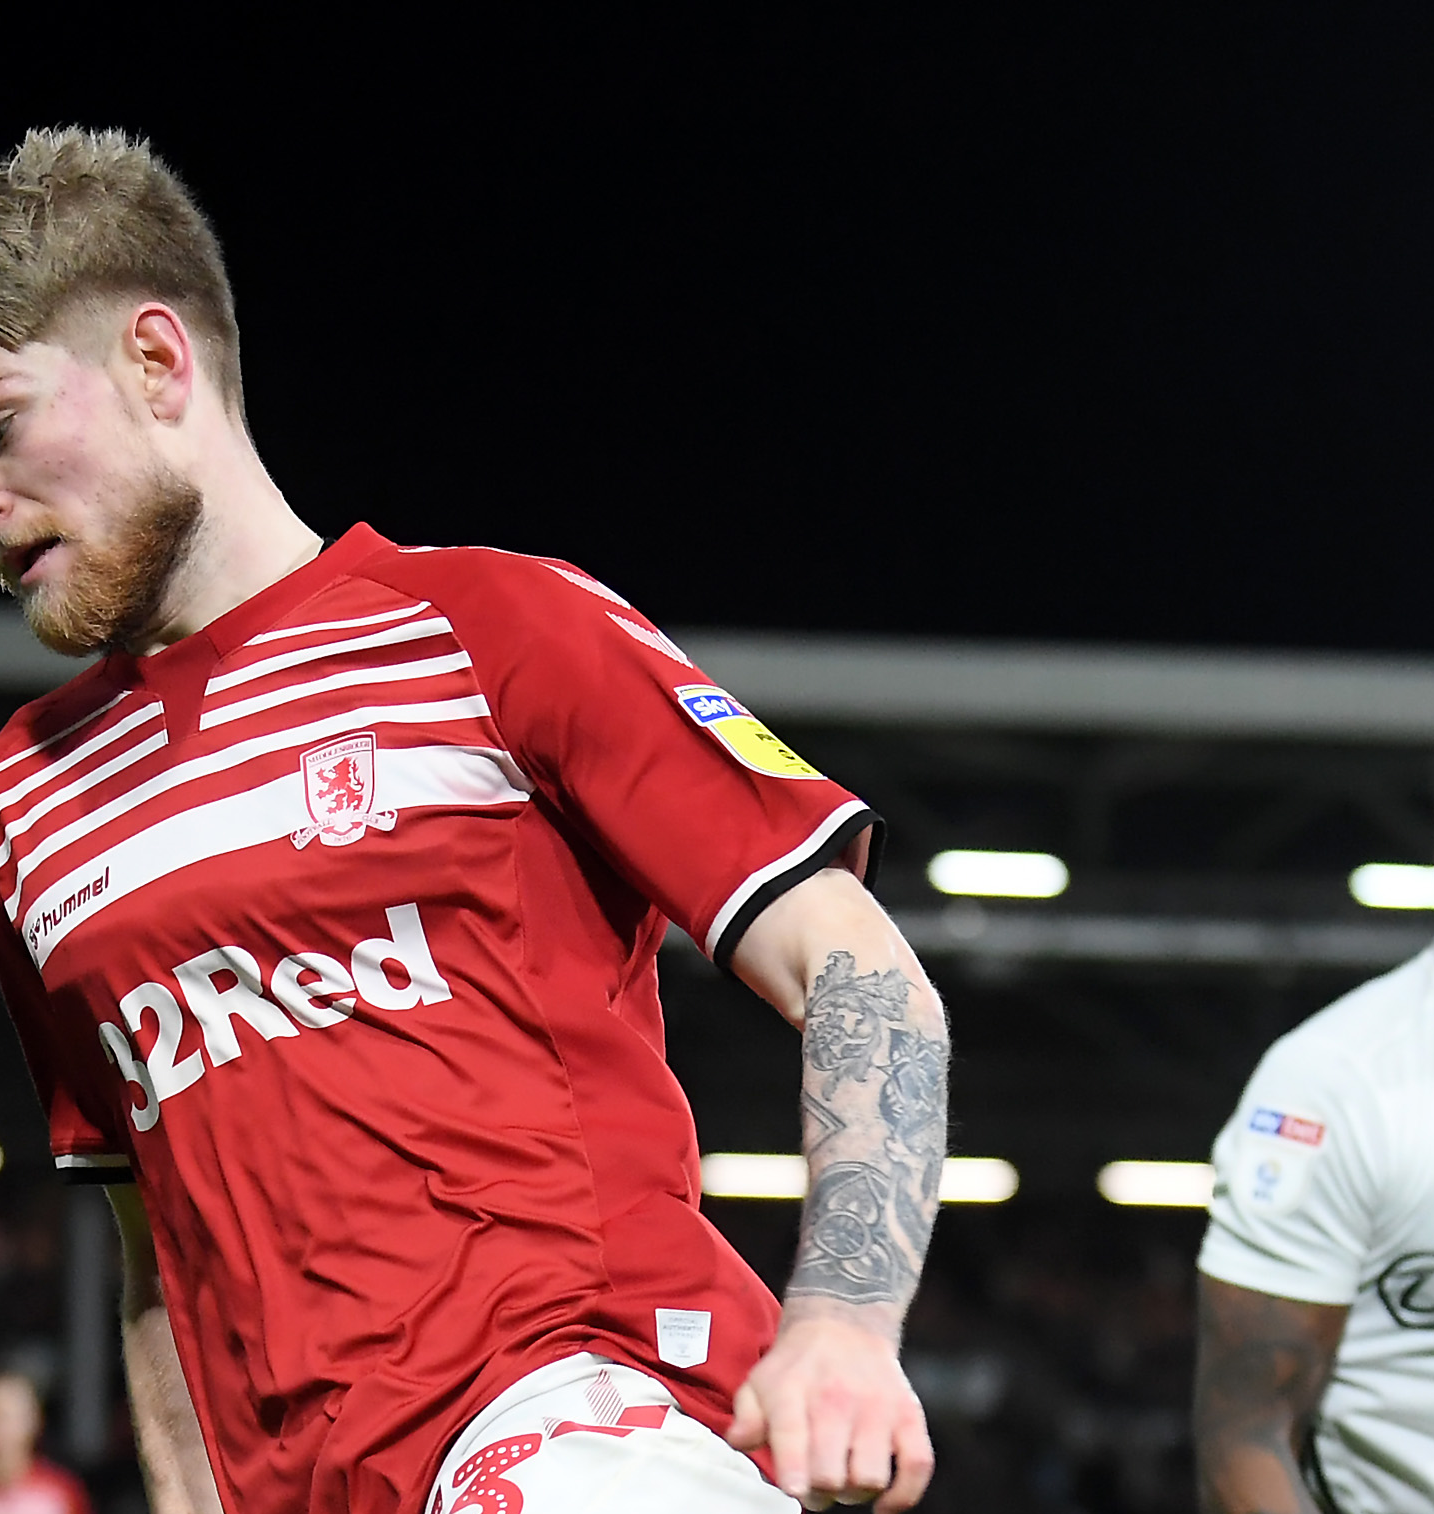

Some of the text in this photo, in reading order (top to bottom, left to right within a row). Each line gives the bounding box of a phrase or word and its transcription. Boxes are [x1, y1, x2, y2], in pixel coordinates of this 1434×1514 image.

[692, 696, 734, 718] sky
[41, 866, 110, 937] hummel
[97, 902, 453, 1133] 32Red
